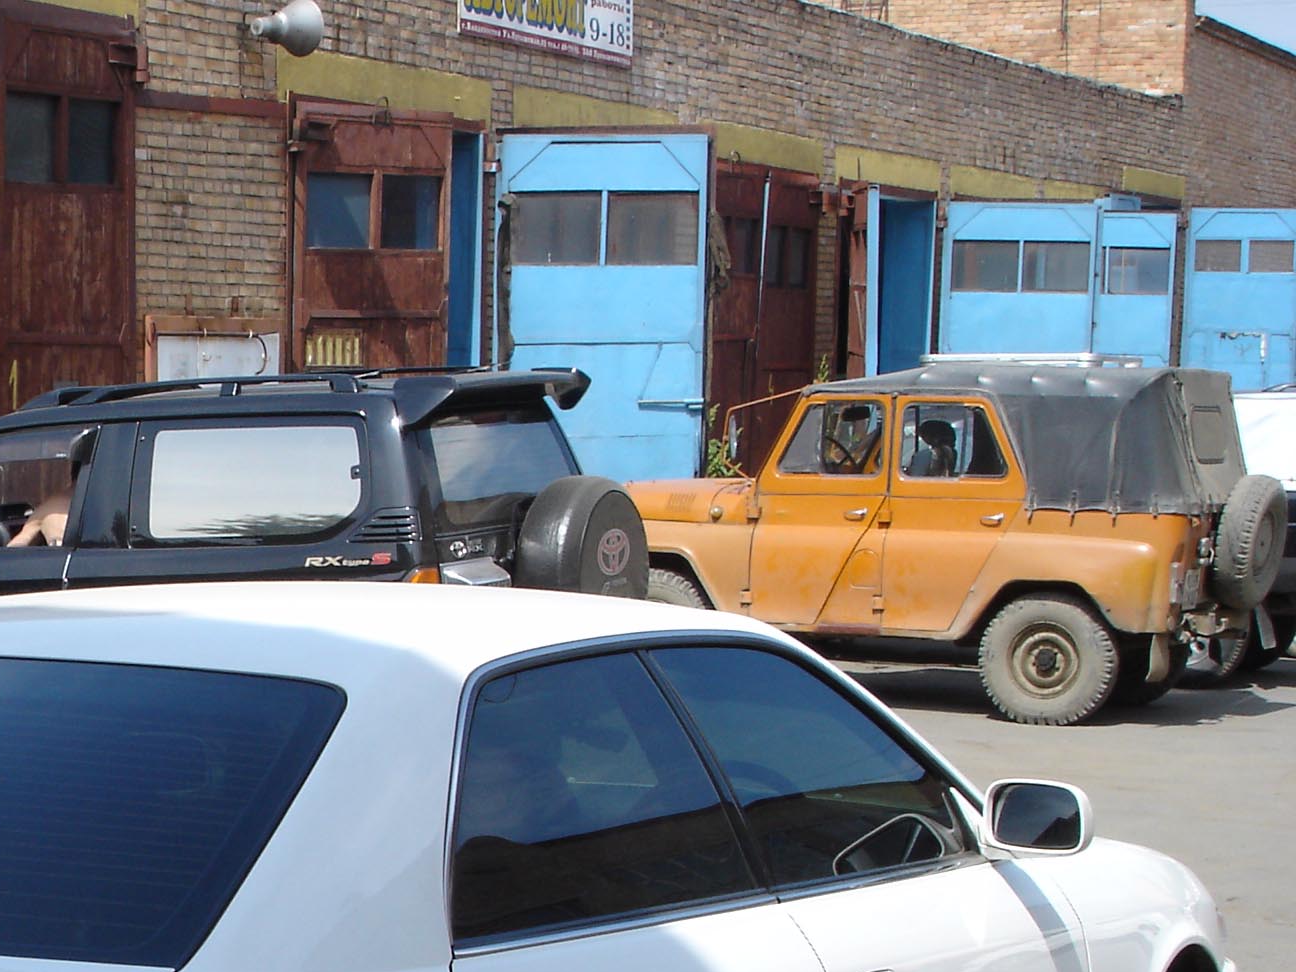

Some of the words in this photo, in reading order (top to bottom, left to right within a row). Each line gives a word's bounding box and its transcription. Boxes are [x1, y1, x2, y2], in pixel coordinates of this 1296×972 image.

[463, 0, 587, 39] РЕМОНТ
[589, 17, 625, 47] 9-18
[304, 556, 343, 568] RX
